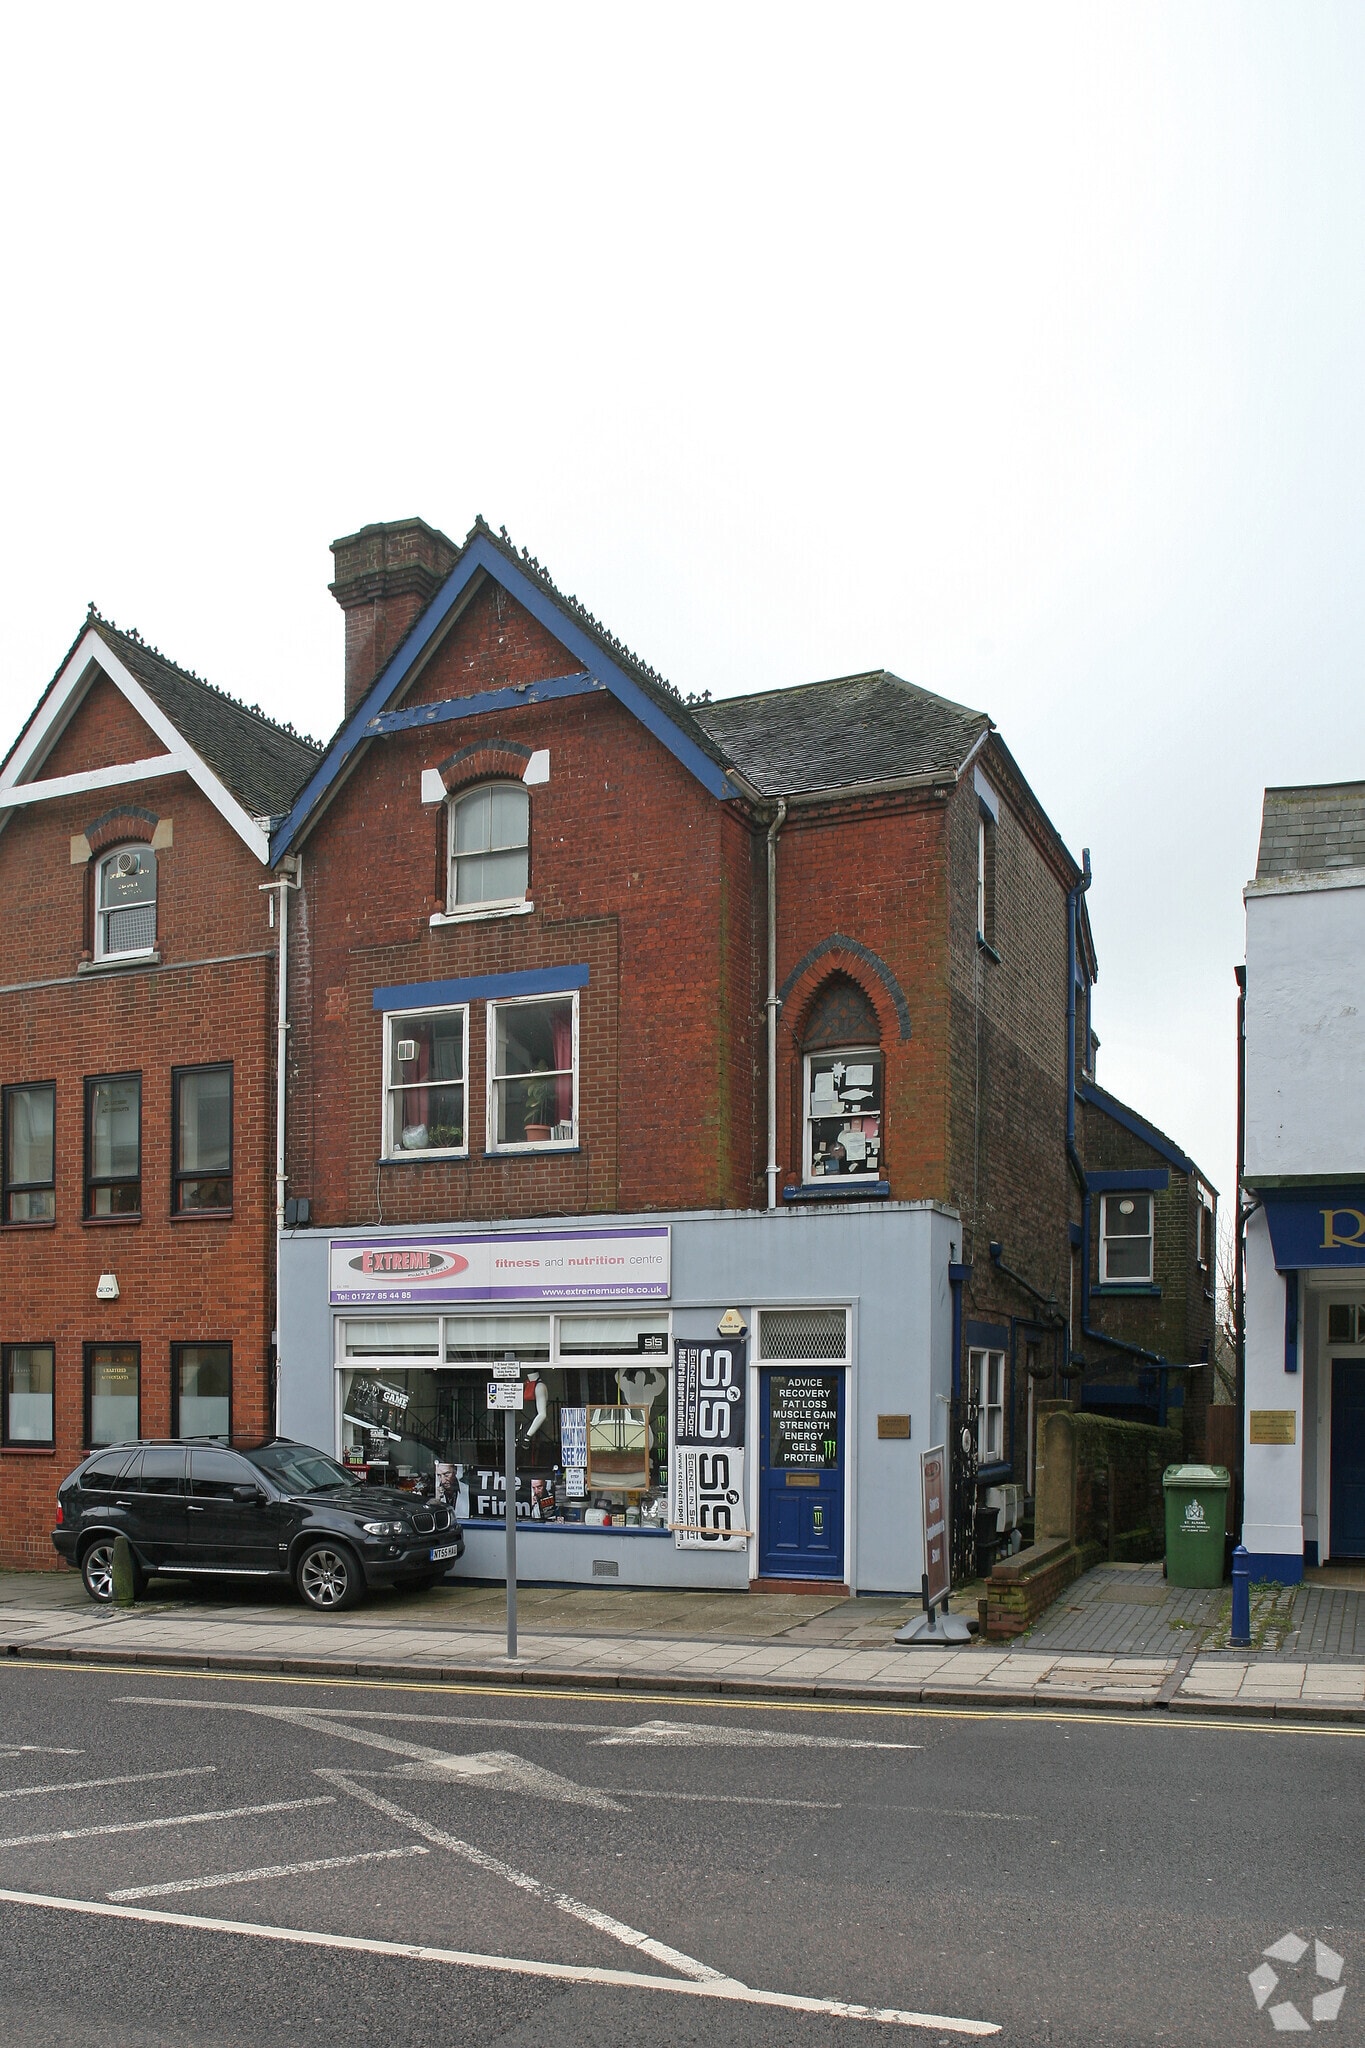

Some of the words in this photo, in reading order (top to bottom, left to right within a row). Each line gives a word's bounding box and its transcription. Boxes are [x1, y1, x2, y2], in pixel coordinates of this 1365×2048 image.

[362, 1250, 431, 1275] EXTREME
[495, 1258, 540, 1268] fitness
[544, 1257, 564, 1266] and
[568, 1255, 625, 1266] nutrition
[630, 1254, 663, 1264] centre
[542, 1286, 662, 1296] www.extrememuscle.co.uk
[383, 1392, 408, 1407] GAME
[690, 1392, 696, 1401] IN
[785, 1432, 823, 1440] ENERGY
[792, 1443, 816, 1451] GELS
[562, 1448, 574, 1465] SEE
[784, 1454, 824, 1462] PROTEIN
[477, 1470, 522, 1490] The
[478, 1496, 530, 1516] Firm
[689, 1496, 694, 1505] IN
